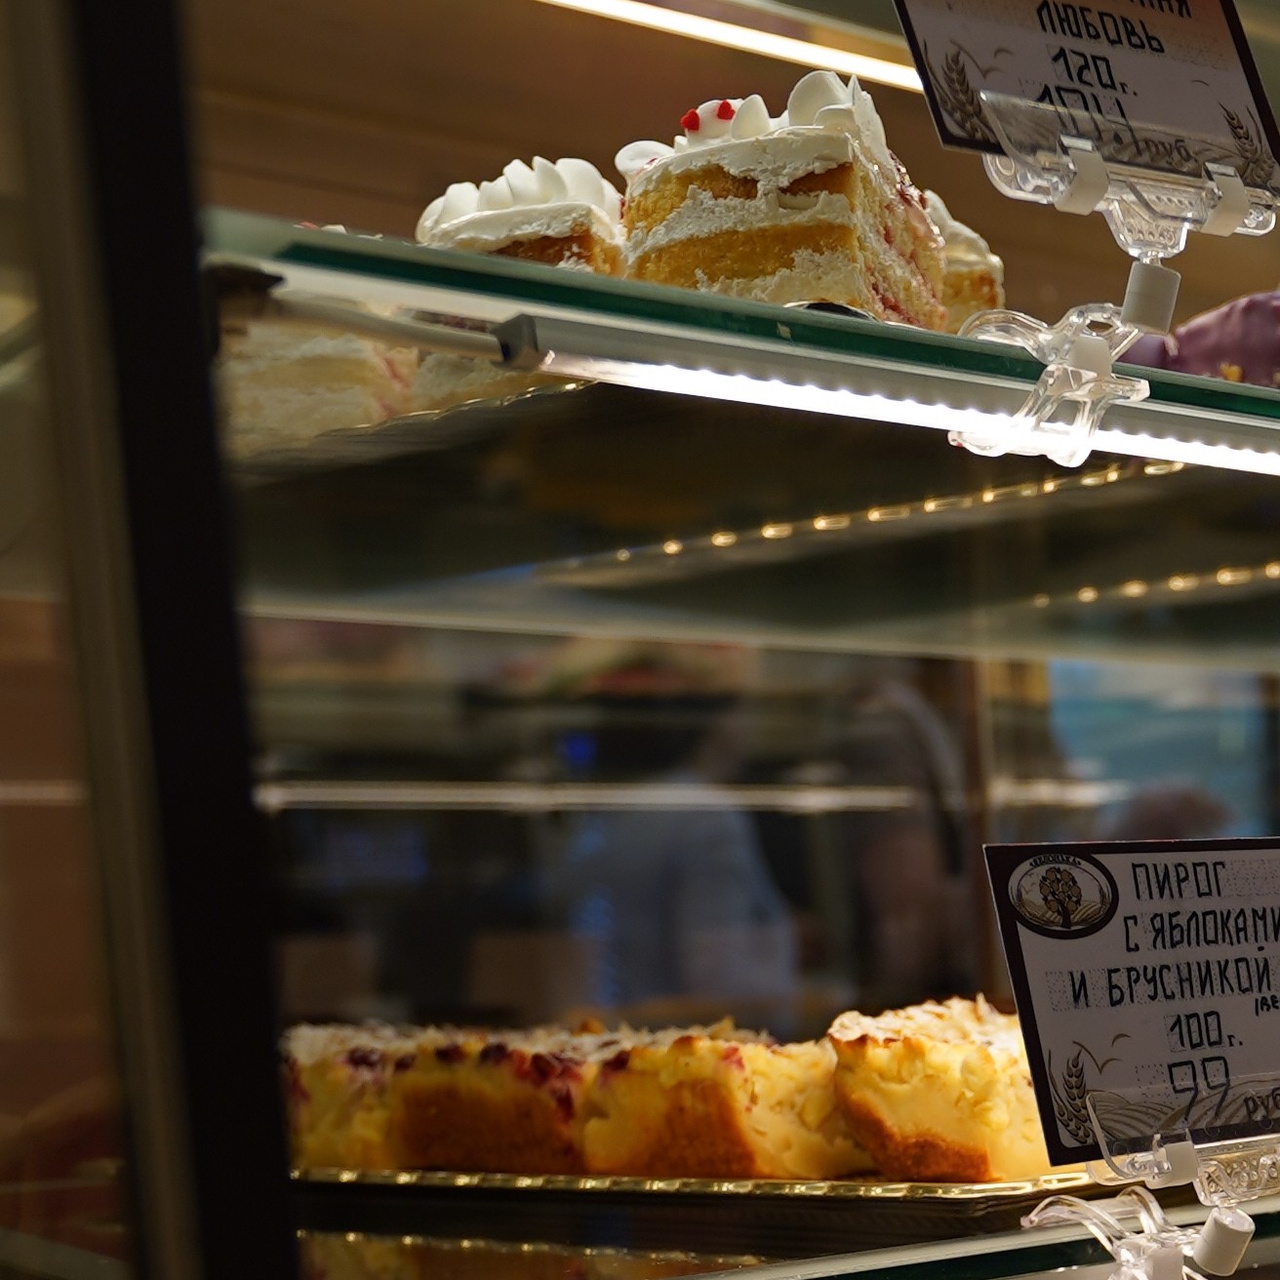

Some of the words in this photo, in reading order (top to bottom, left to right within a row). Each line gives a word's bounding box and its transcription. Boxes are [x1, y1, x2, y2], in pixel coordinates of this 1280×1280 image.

[1037, 0, 1165, 53] ЛЮБОВЬ
[1132, 861, 1225, 900] ПИРОГ
[1124, 915, 1139, 952] С
[1070, 971, 1089, 1007] И
[1108, 946, 1272, 1007] БРУСНИКОЙ
[1167, 1056, 1231, 1121] 99
